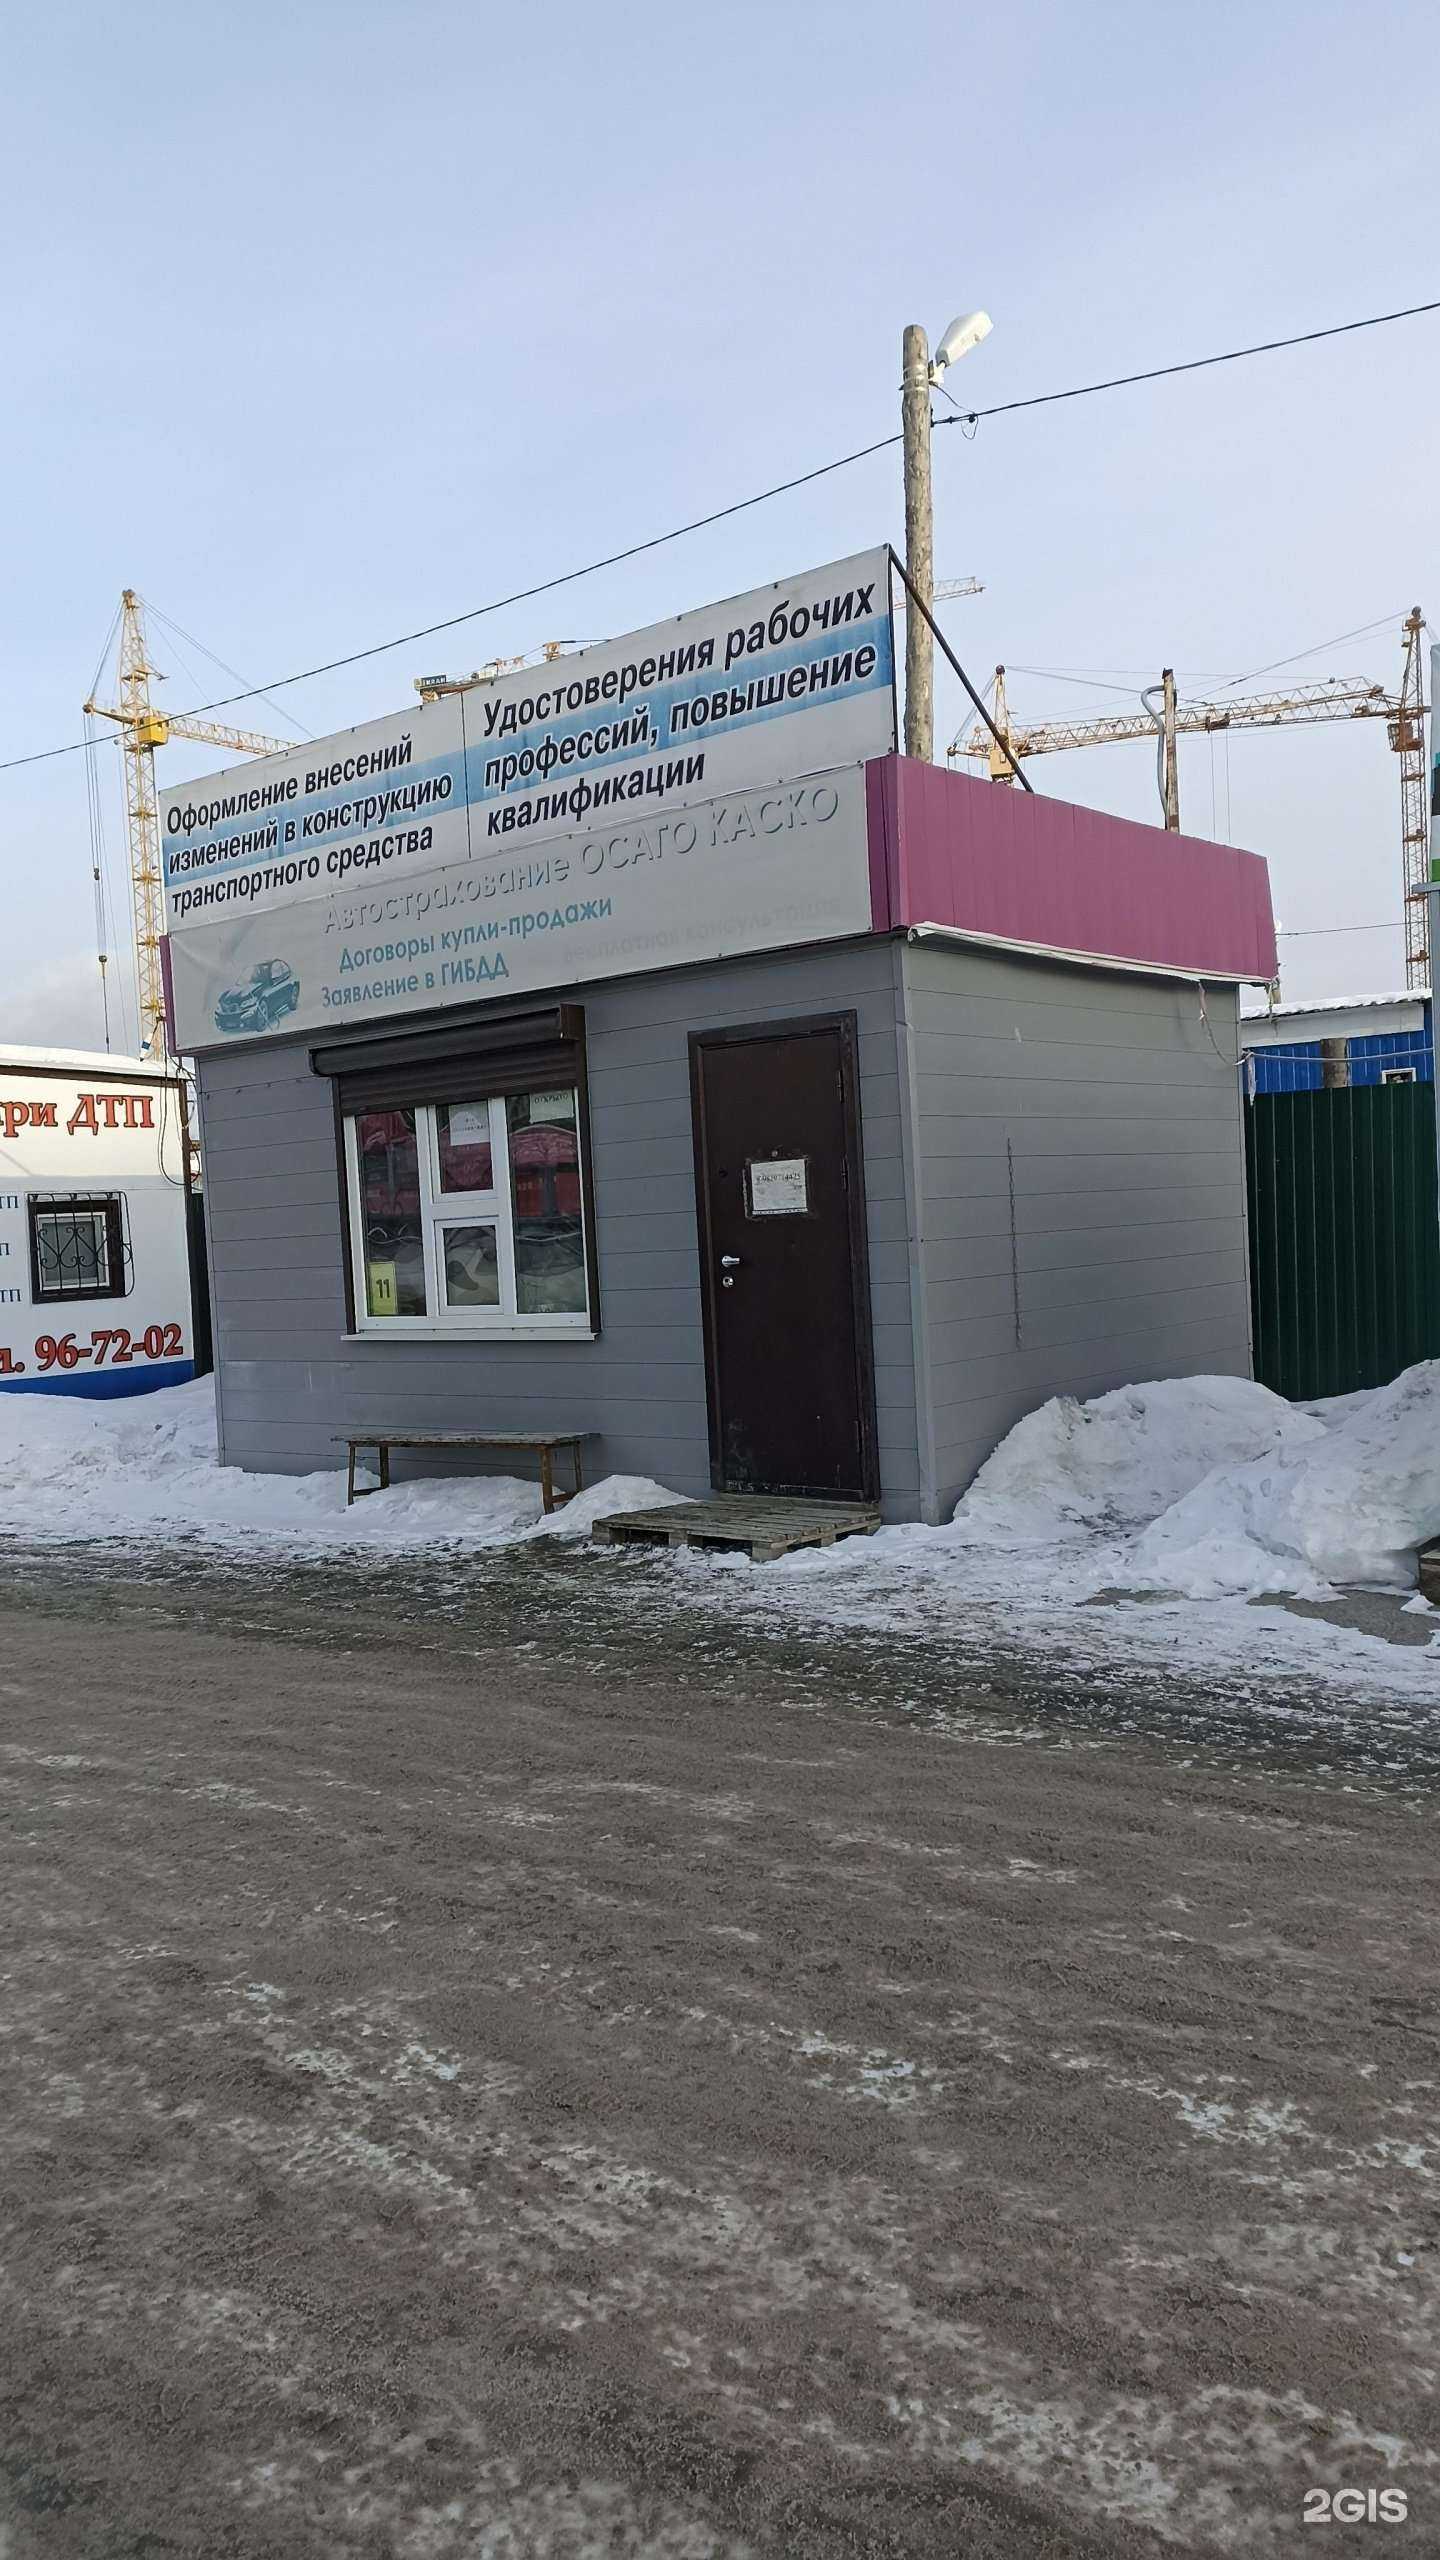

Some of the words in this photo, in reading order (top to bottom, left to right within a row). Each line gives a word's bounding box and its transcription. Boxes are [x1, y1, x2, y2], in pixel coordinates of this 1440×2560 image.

[482, 639, 716, 739] Удостоверения
[724, 583, 876, 671] рабочих
[484, 704, 659, 792] профессий,
[670, 643, 877, 734] повышение
[167, 776, 298, 836] Оформление
[304, 734, 413, 795] внесений
[169, 819, 278, 874] изменений
[284, 820, 296, 843] в
[302, 773, 452, 839] конструкцию
[487, 754, 706, 837] квалификации
[172, 856, 320, 918] транспортного
[327, 825, 433, 879] средства
[323, 856, 570, 934] Автострахование
[582, 821, 697, 876] ОСАГО
[709, 787, 840, 847] КАСКО
[339, 934, 435, 974] Договоры
[441, 898, 612, 951] купли-продажи
[322, 973, 418, 1009] Заявление
[425, 970, 435, 989] в
[441, 952, 510, 987] ГИБДД
[0, 1101, 58, 1138] ри
[67, 1094, 155, 1135] ДТП
[376, 1279, 390, 1298] 11
[34, 1323, 183, 1371] 96-72-02
